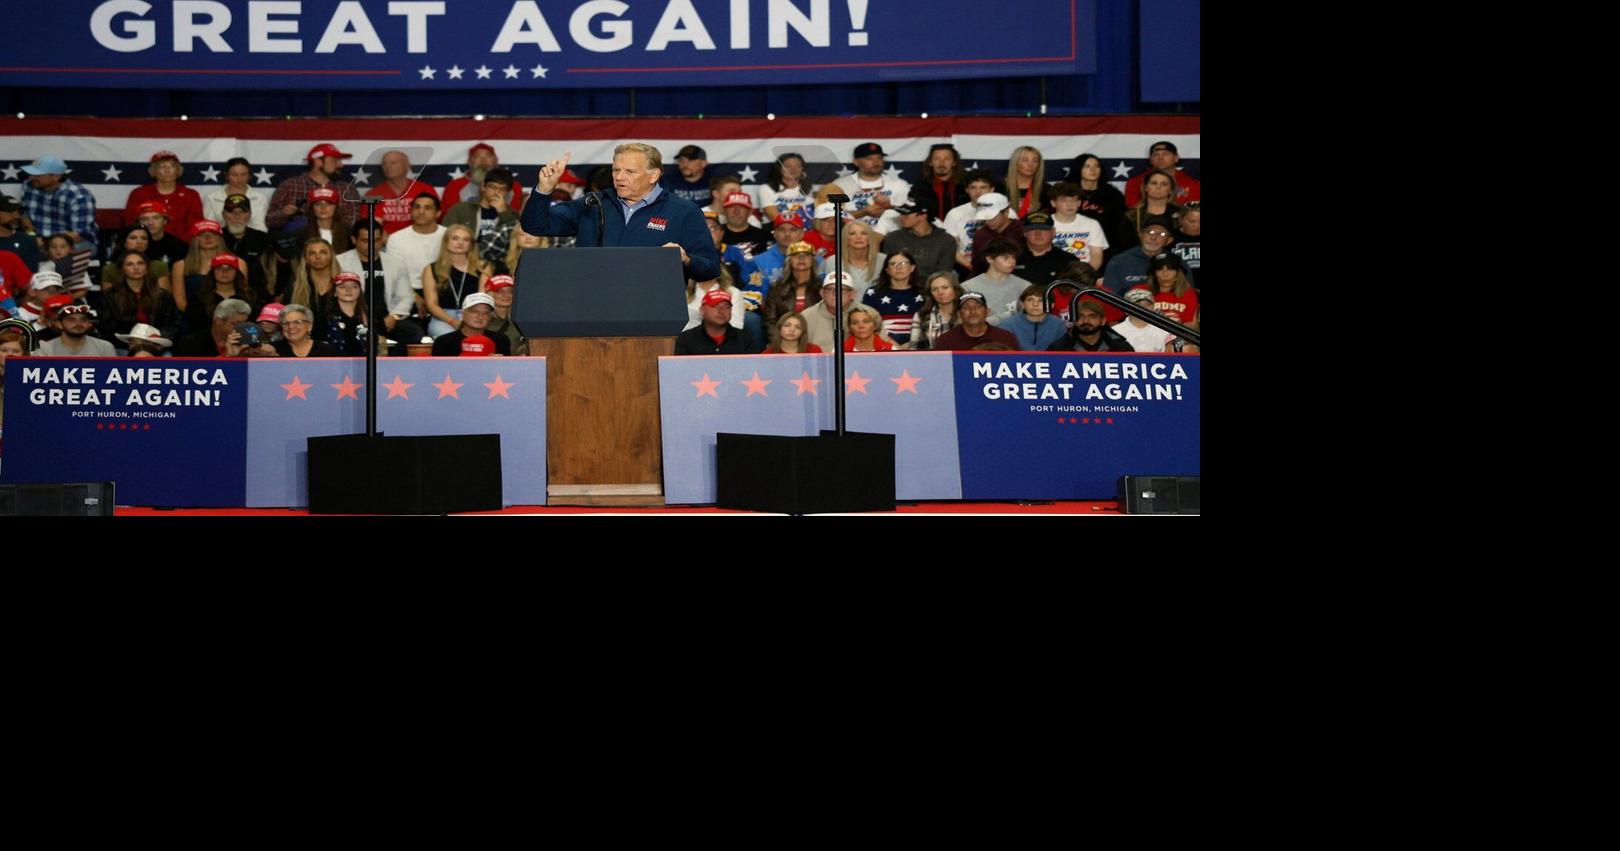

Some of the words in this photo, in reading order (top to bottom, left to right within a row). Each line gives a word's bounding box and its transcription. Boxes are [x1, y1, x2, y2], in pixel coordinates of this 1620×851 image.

[90, 0, 446, 53] GREAT
[490, 0, 869, 52] AGAIN!
[1154, 301, 1187, 313] RUMP
[22, 367, 96, 384] MAKE
[105, 368, 228, 385] AMERICA
[972, 362, 1051, 379] MAKE
[1061, 363, 1188, 380] AMERICA
[29, 389, 116, 406] GREAT
[125, 389, 221, 406] AGAIN!
[983, 383, 1074, 400] GREAT
[1085, 384, 1183, 400] AGAIN!
[97, 411, 131, 419] HURON,
[133, 411, 176, 419] MICHIGAN
[1056, 405, 1092, 413] HURON,
